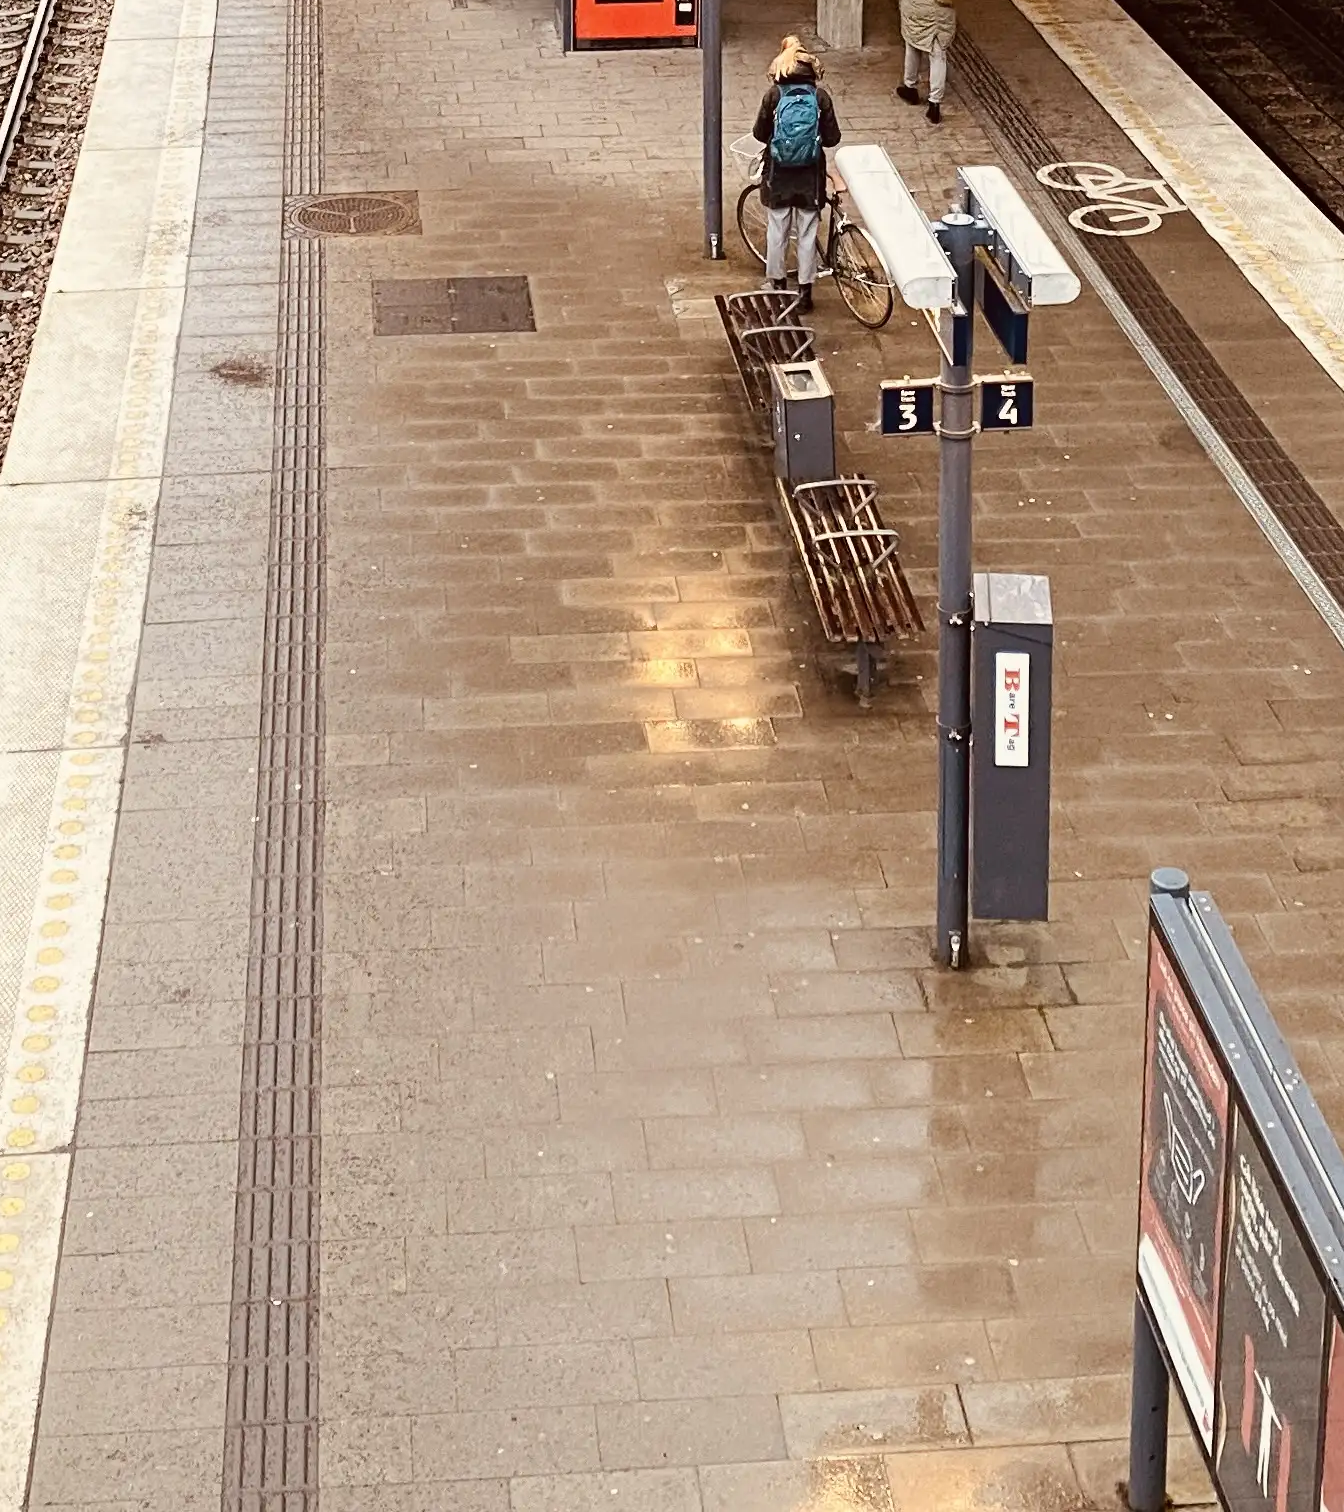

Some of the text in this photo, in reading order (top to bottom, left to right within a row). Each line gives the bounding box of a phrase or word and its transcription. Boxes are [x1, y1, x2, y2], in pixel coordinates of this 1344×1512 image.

[898, 404, 918, 431] 3
[998, 398, 1018, 425] 4
[1003, 667, 1021, 751] Bare Tag
